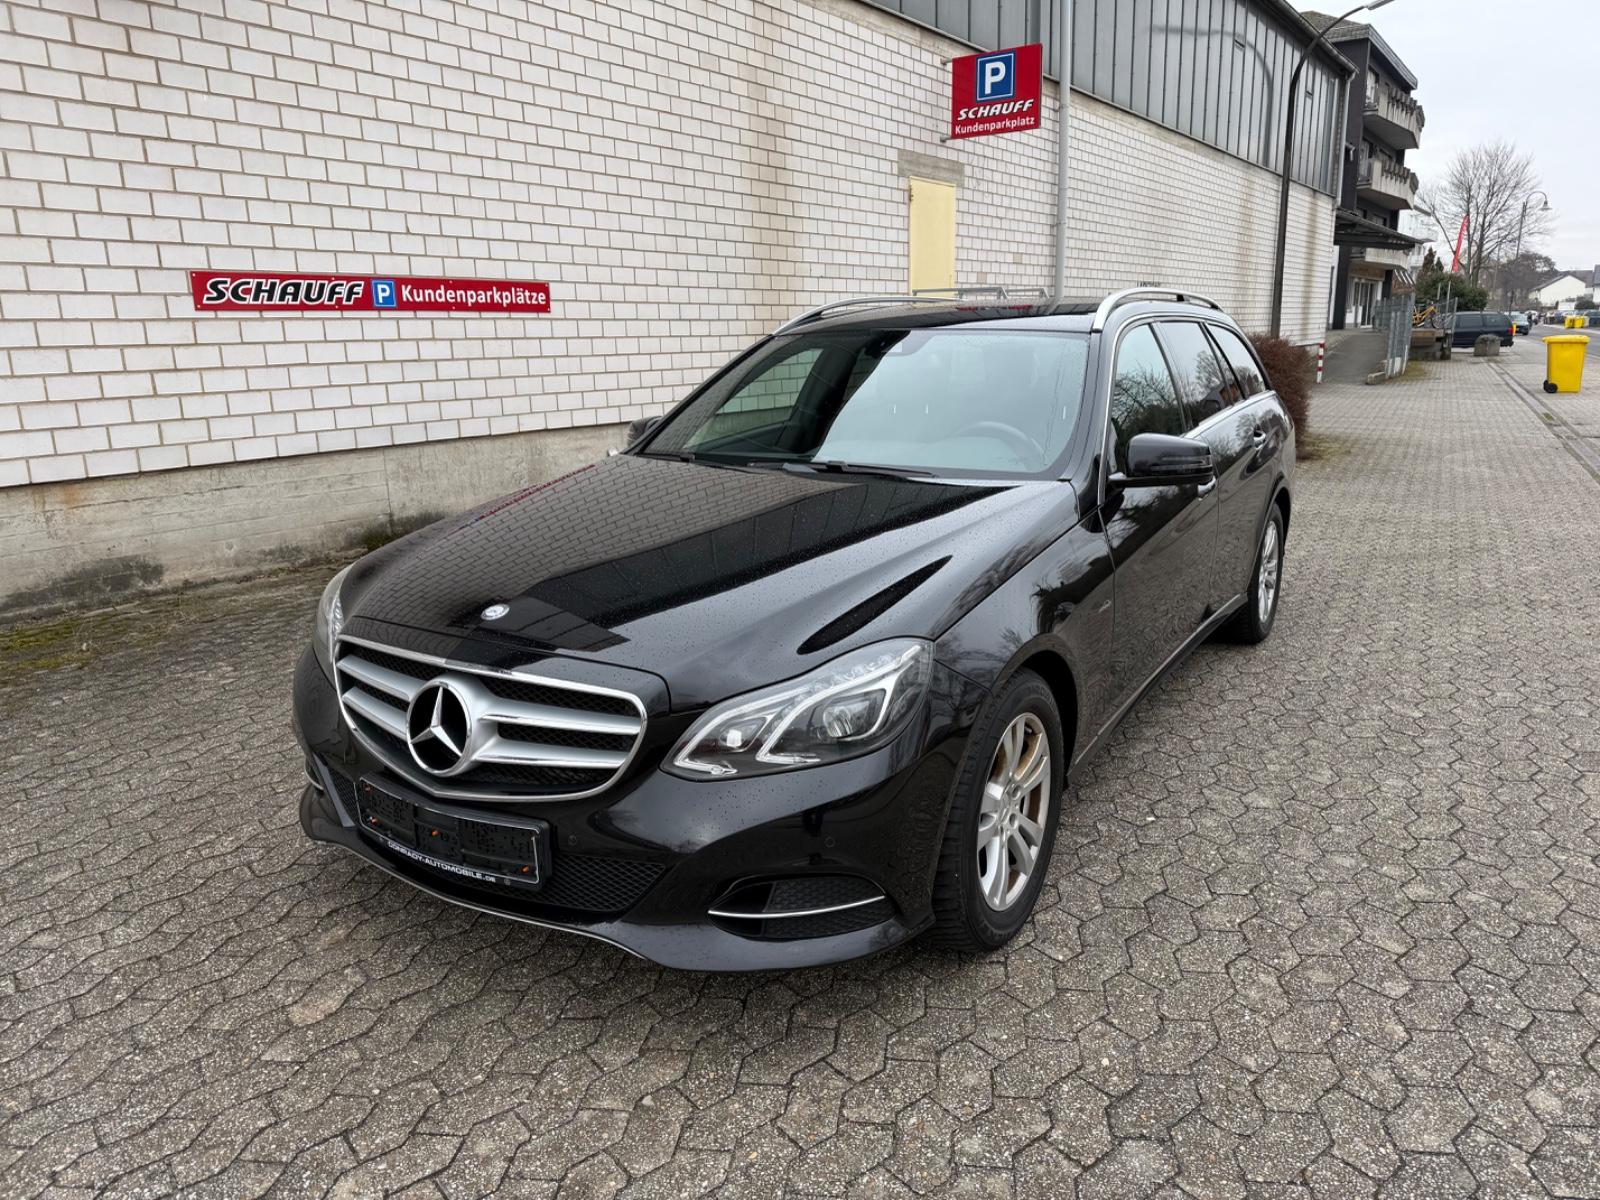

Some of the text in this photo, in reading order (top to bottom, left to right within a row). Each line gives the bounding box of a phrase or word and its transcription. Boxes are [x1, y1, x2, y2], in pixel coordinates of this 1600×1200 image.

[984, 61, 1006, 95] P
[957, 98, 1034, 121] SCHAUFF
[954, 117, 1035, 134] Kundenparkplatz
[202, 278, 547, 307] SCHAUFF P Kundenparkplätze
